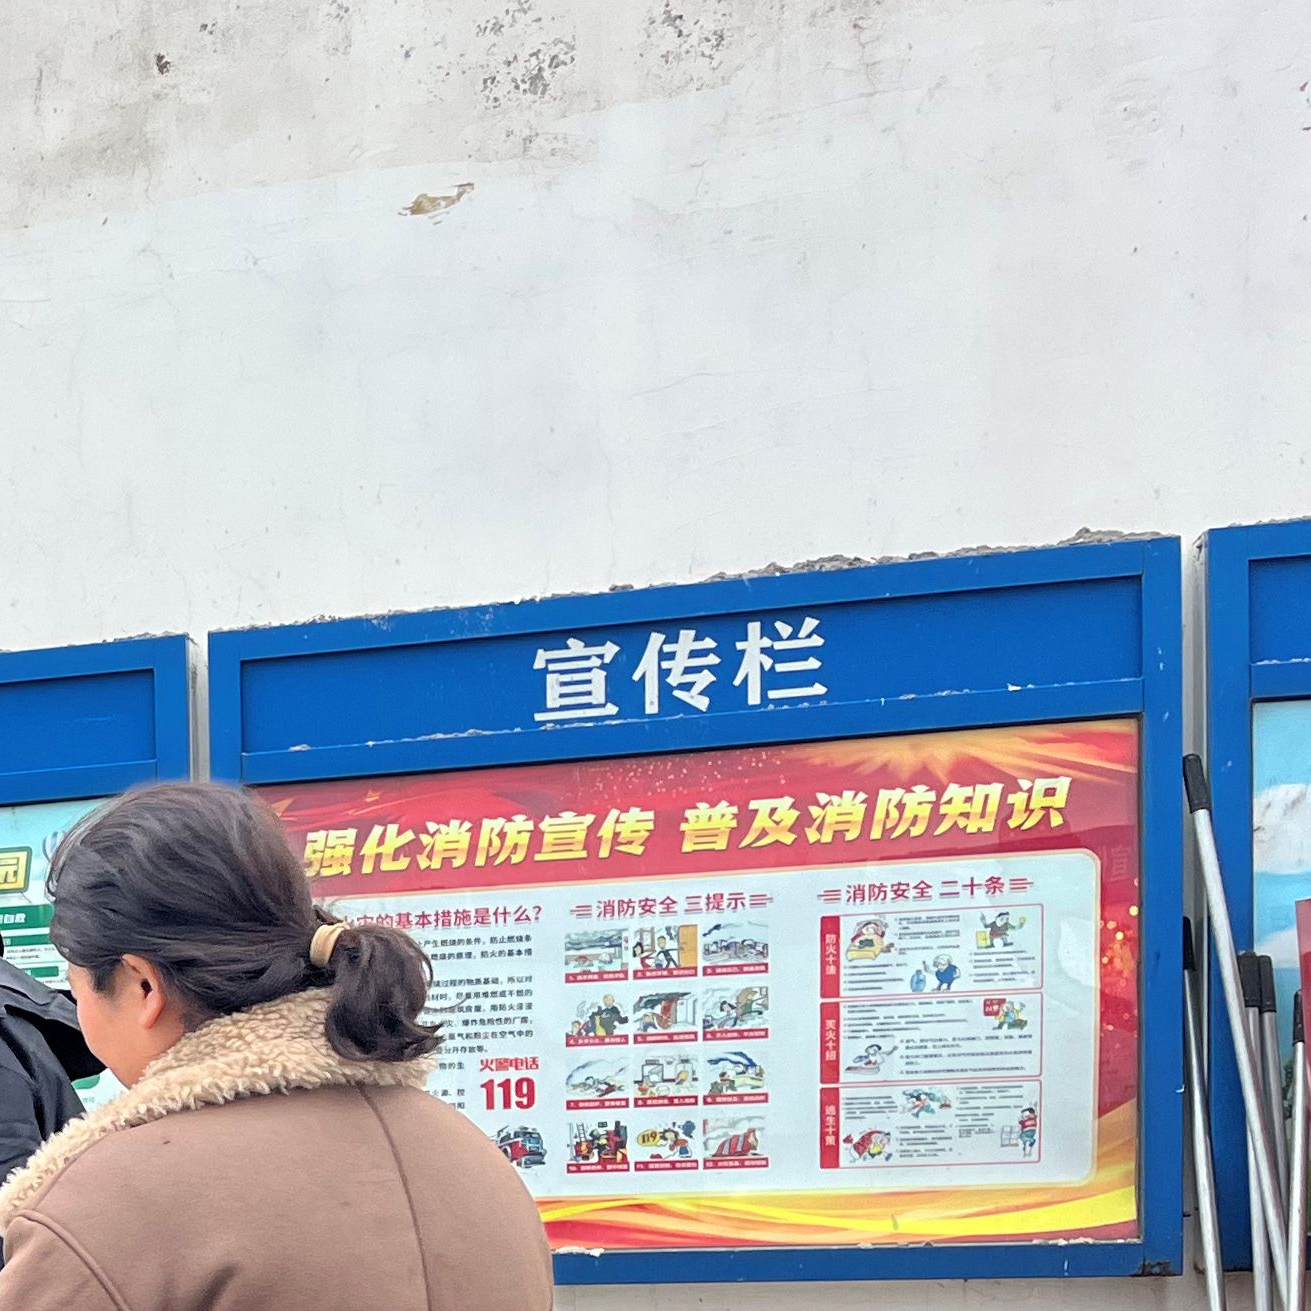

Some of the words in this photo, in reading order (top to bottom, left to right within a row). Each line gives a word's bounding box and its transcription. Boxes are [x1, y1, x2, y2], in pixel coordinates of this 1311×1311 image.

[534, 617, 828, 723] 宣传栏
[302, 807, 656, 876] 强化消防宣传
[679, 776, 1072, 854] 普及消防知识
[597, 895, 678, 918] 消防安全
[684, 892, 746, 913] 三提示
[846, 880, 933, 903] 消防安全
[939, 876, 1004, 896] 二十条
[480, 1077, 535, 1110] 119
